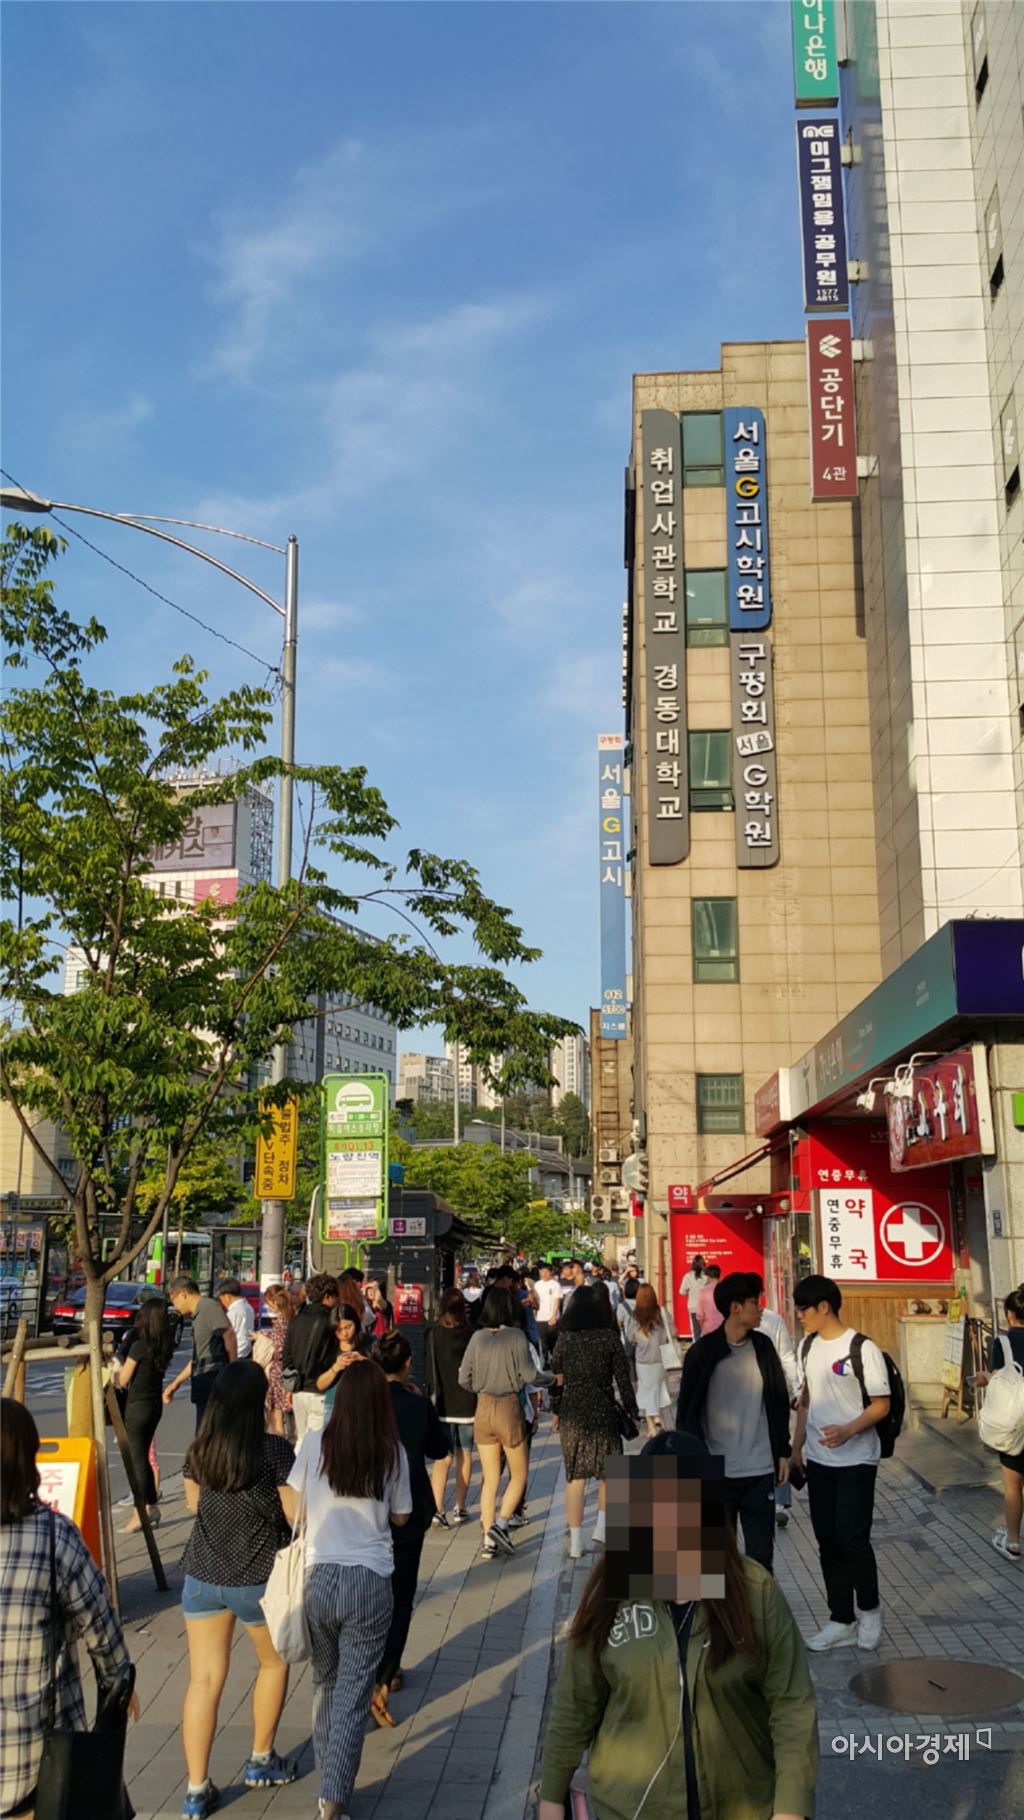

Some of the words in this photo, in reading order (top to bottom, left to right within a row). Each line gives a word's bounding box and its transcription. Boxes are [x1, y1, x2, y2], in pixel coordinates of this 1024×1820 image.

[819, 367, 844, 447] 공단기
[822, 466, 846, 481] 4관
[650, 446, 679, 634] 취업사관학교
[733, 421, 766, 610] 서울G고시학원
[653, 663, 683, 820] 경동대학교
[739, 733, 771, 754] 서울
[600, 763, 622, 887] 서울G고시
[672, 1186, 689, 1205] 약
[817, 1169, 868, 1182] 연중무휴
[826, 1198, 843, 1270] 연중무휴
[845, 1198, 869, 1270] 약국
